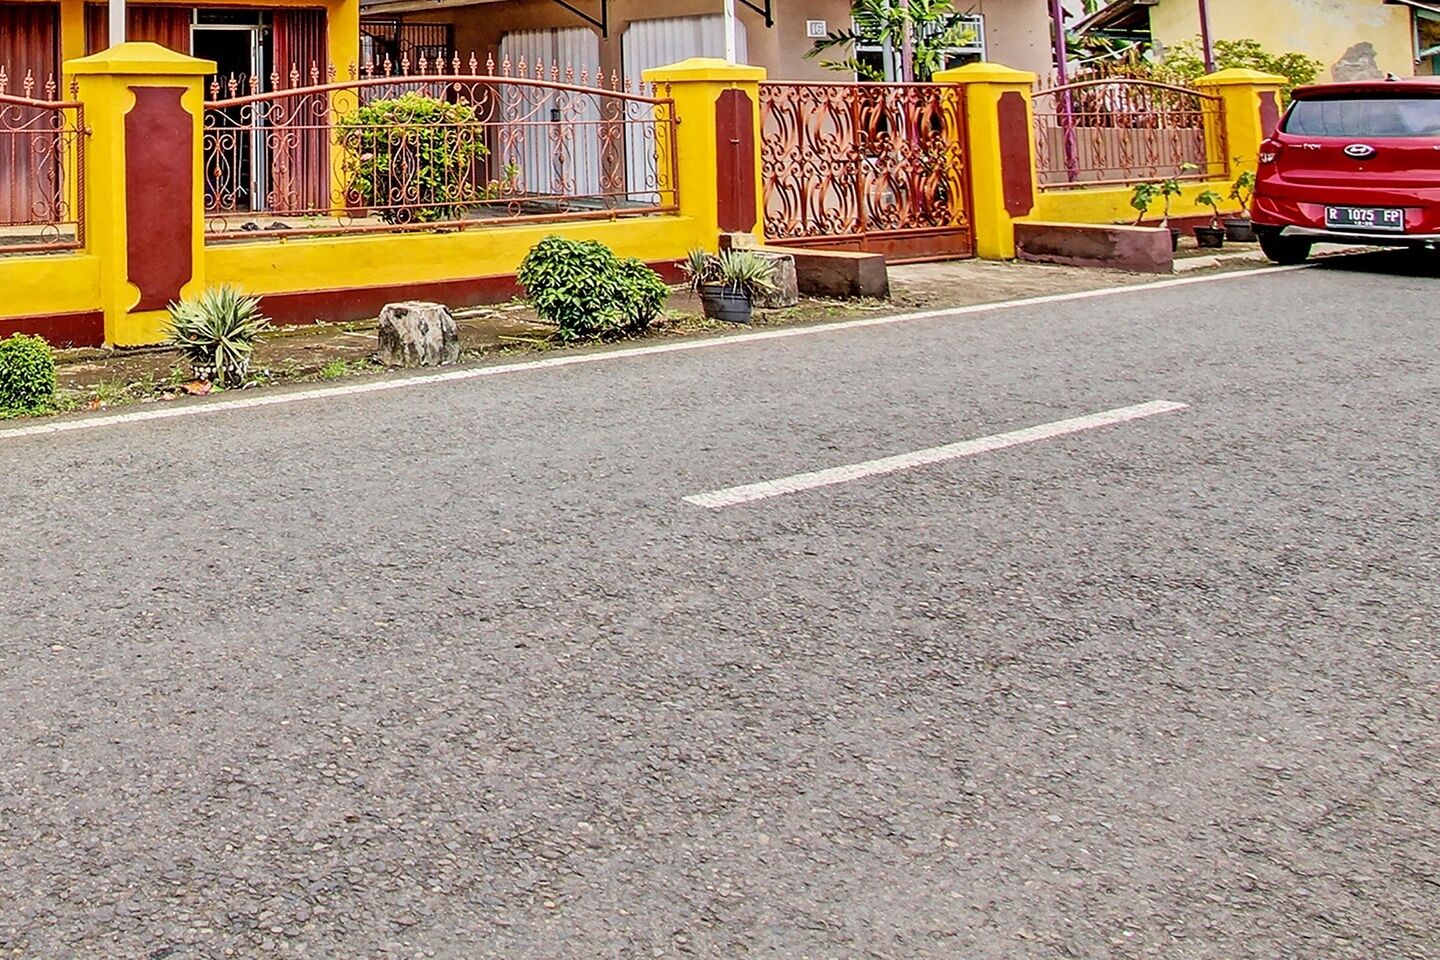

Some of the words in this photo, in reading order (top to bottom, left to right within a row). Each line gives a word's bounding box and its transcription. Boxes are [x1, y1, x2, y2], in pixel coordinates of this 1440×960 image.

[812, 23, 823, 35] 16
[1329, 208, 1338, 220] R
[1348, 209, 1374, 221] 1075
[1384, 210, 1399, 222] FP
